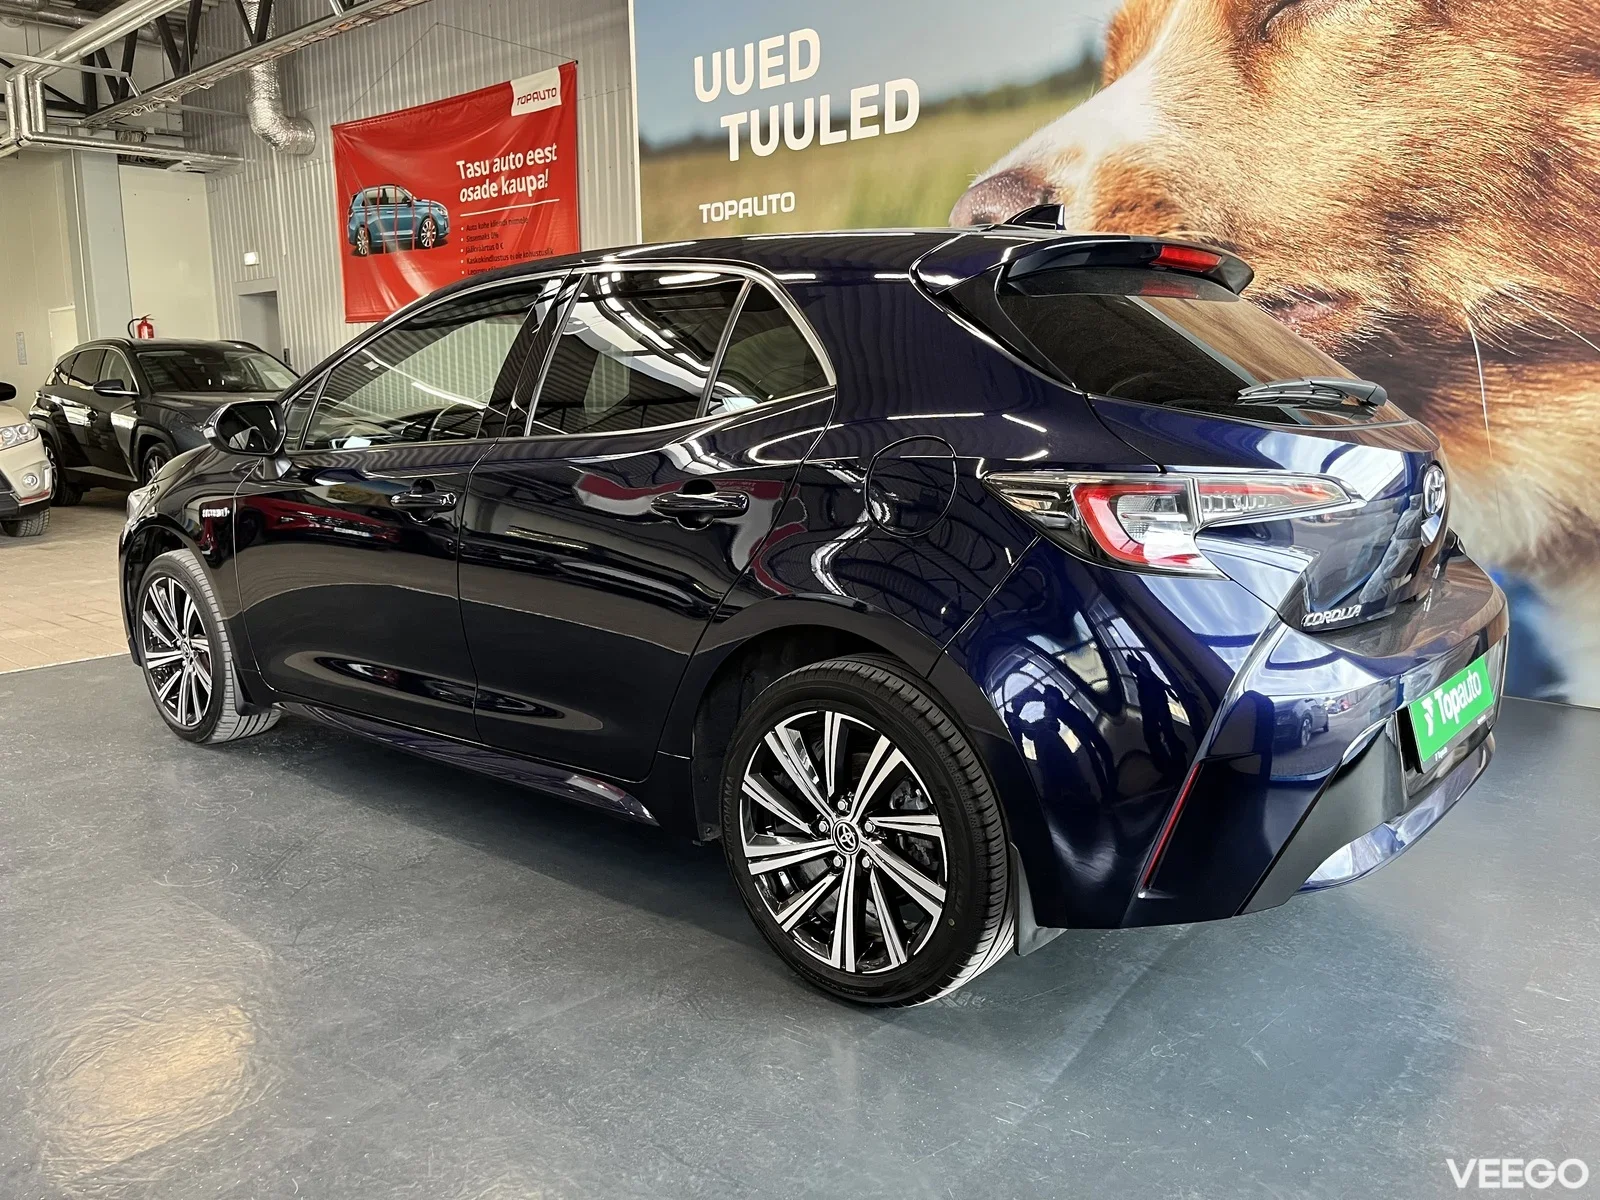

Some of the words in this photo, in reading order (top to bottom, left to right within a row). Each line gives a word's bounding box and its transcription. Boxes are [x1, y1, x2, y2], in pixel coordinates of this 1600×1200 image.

[694, 28, 821, 103] UUED
[516, 87, 557, 106] TOPAUTO
[720, 77, 921, 162] TUULED
[456, 160, 490, 179] Tasu
[492, 151, 523, 174] auto
[526, 142, 558, 166] eest
[459, 178, 498, 203] osade
[501, 168, 549, 197] kaupa!
[699, 191, 796, 224] TOPAUTO
[1433, 669, 1482, 725] Topauto
[723, 776, 735, 851] YOKOHAMA
